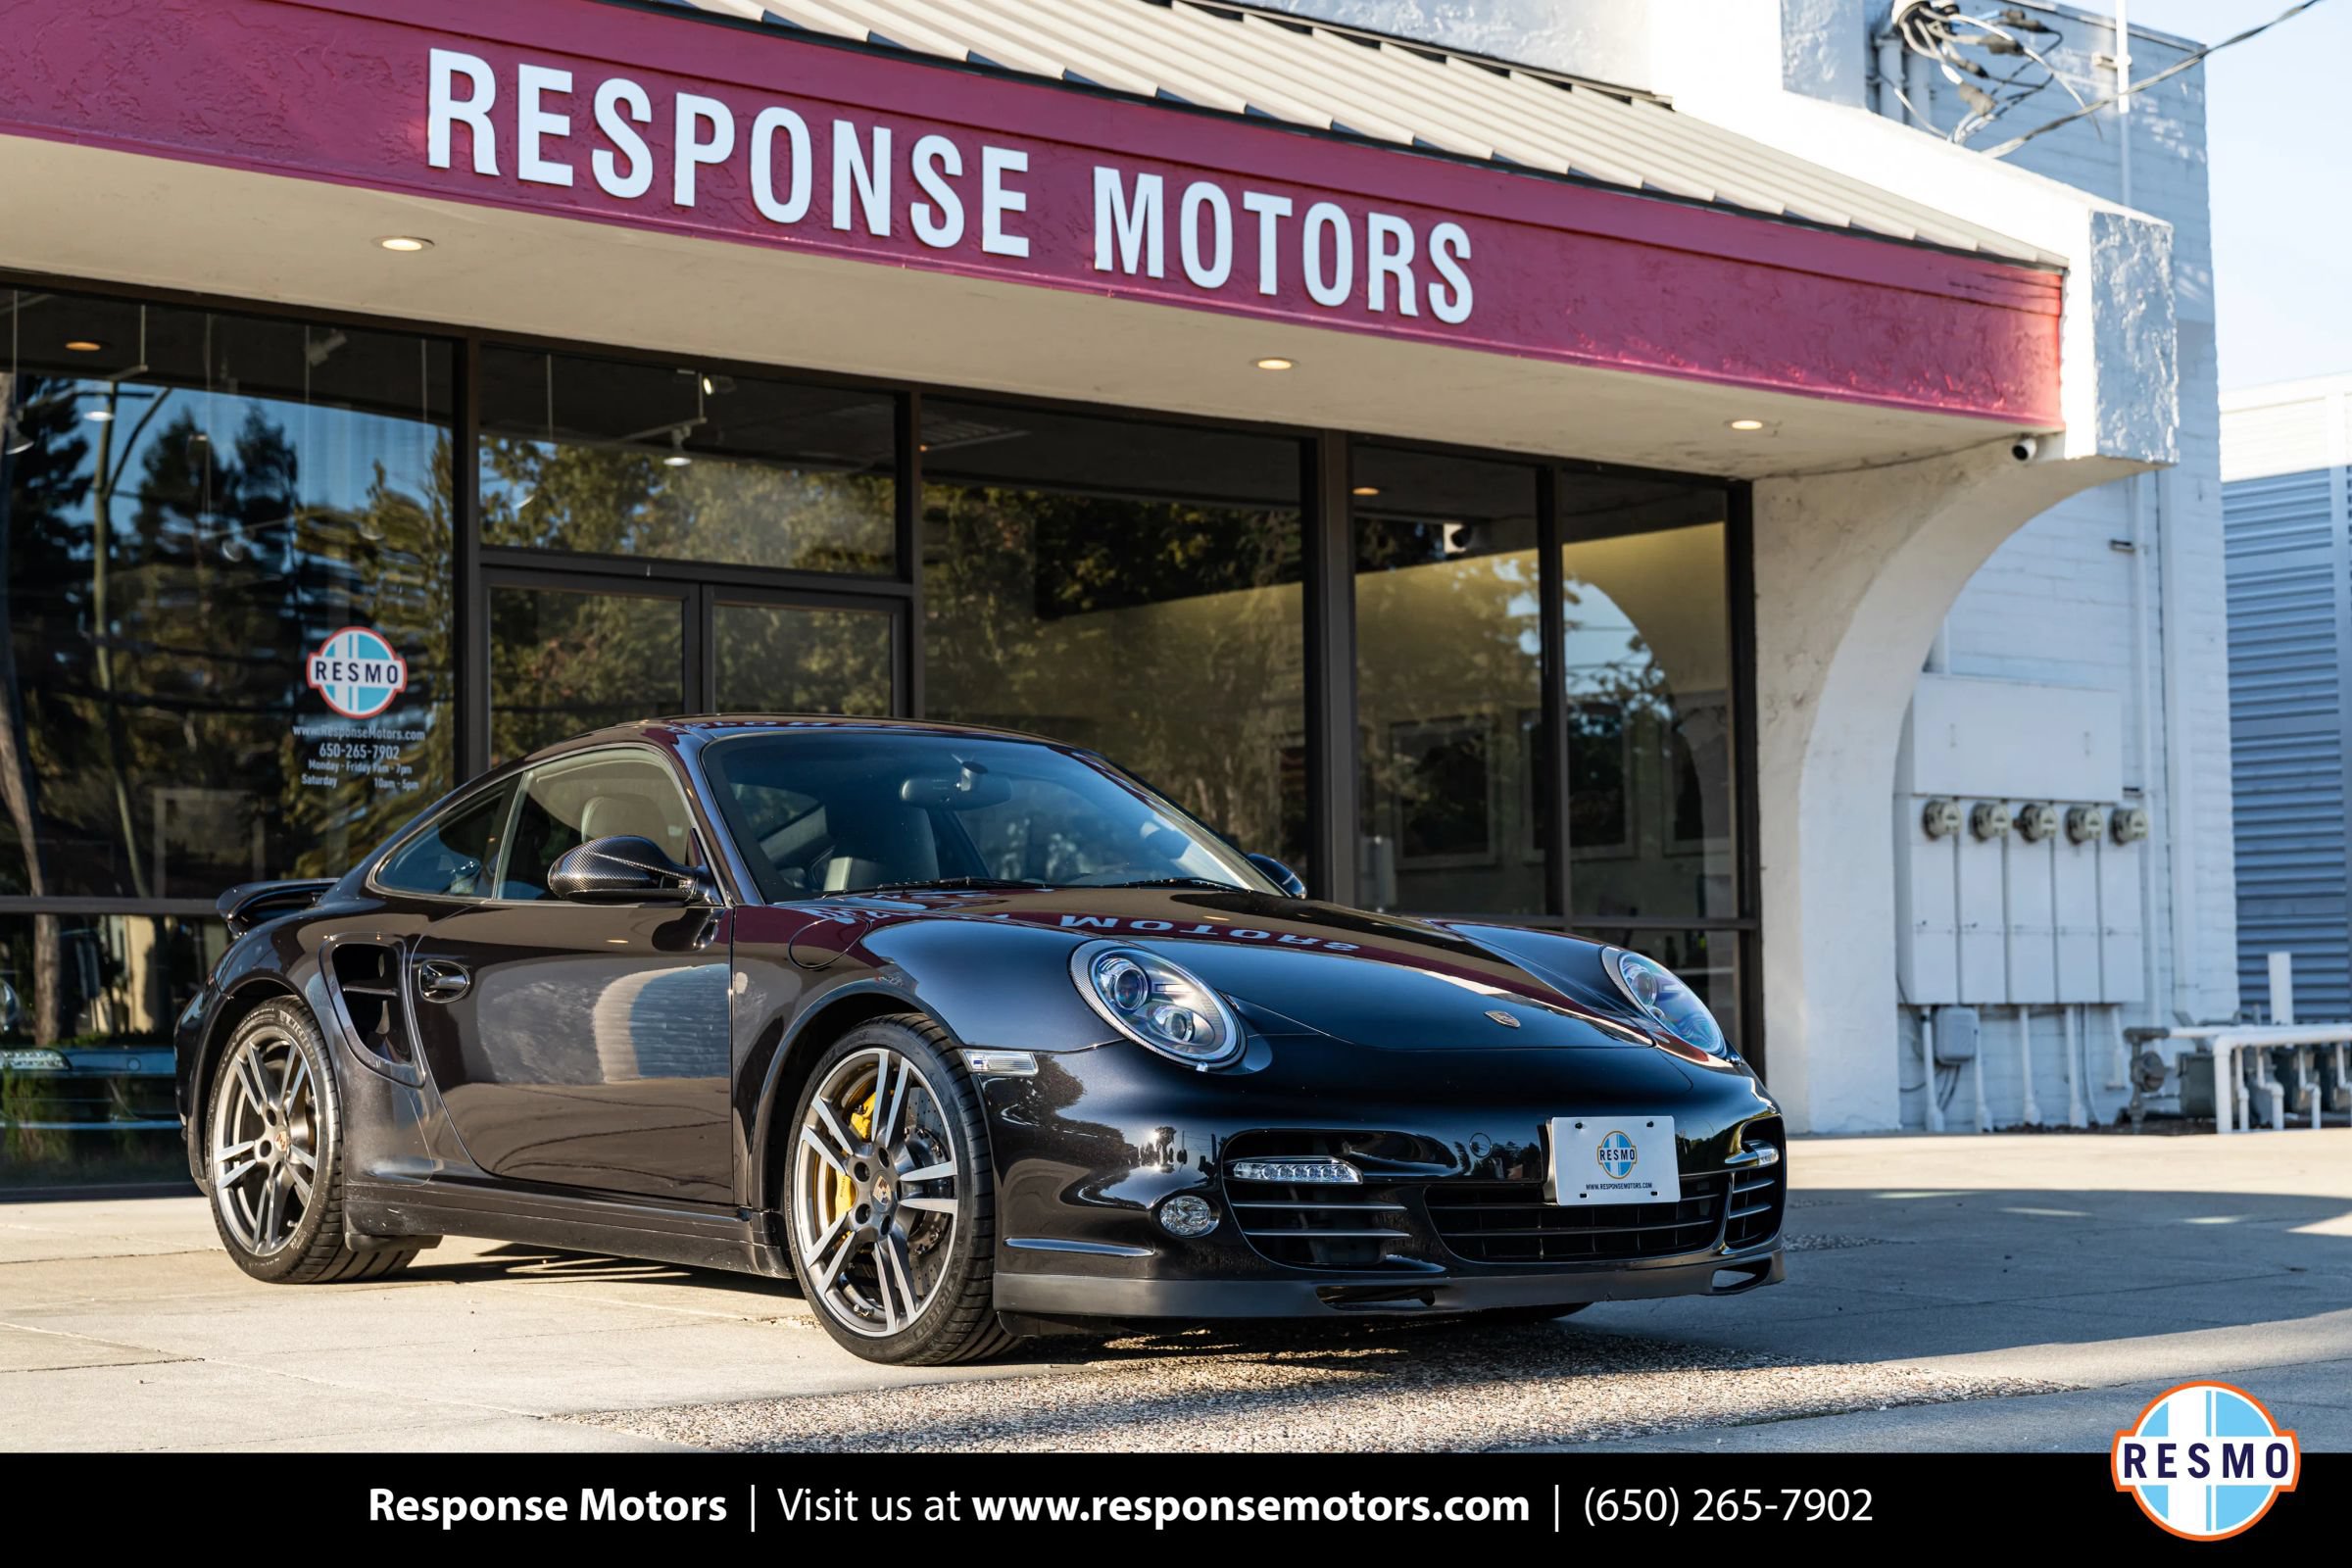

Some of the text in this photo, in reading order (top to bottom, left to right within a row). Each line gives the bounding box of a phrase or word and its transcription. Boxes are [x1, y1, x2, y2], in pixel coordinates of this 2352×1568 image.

[427, 47, 1475, 324] RESPONSE MOTORS
[315, 661, 399, 685] RESMO
[318, 742, 401, 760] 650-265-7902
[308, 759, 340, 773] Monday
[346, 760, 371, 775] Friday
[396, 763, 413, 776] 7pm
[301, 773, 338, 789] Saturday
[402, 778, 419, 792] 5pm
[1599, 1149, 1636, 1161] RESMO
[1586, 1182, 1652, 1191] WWW.RESPONSEMOTORS.COM
